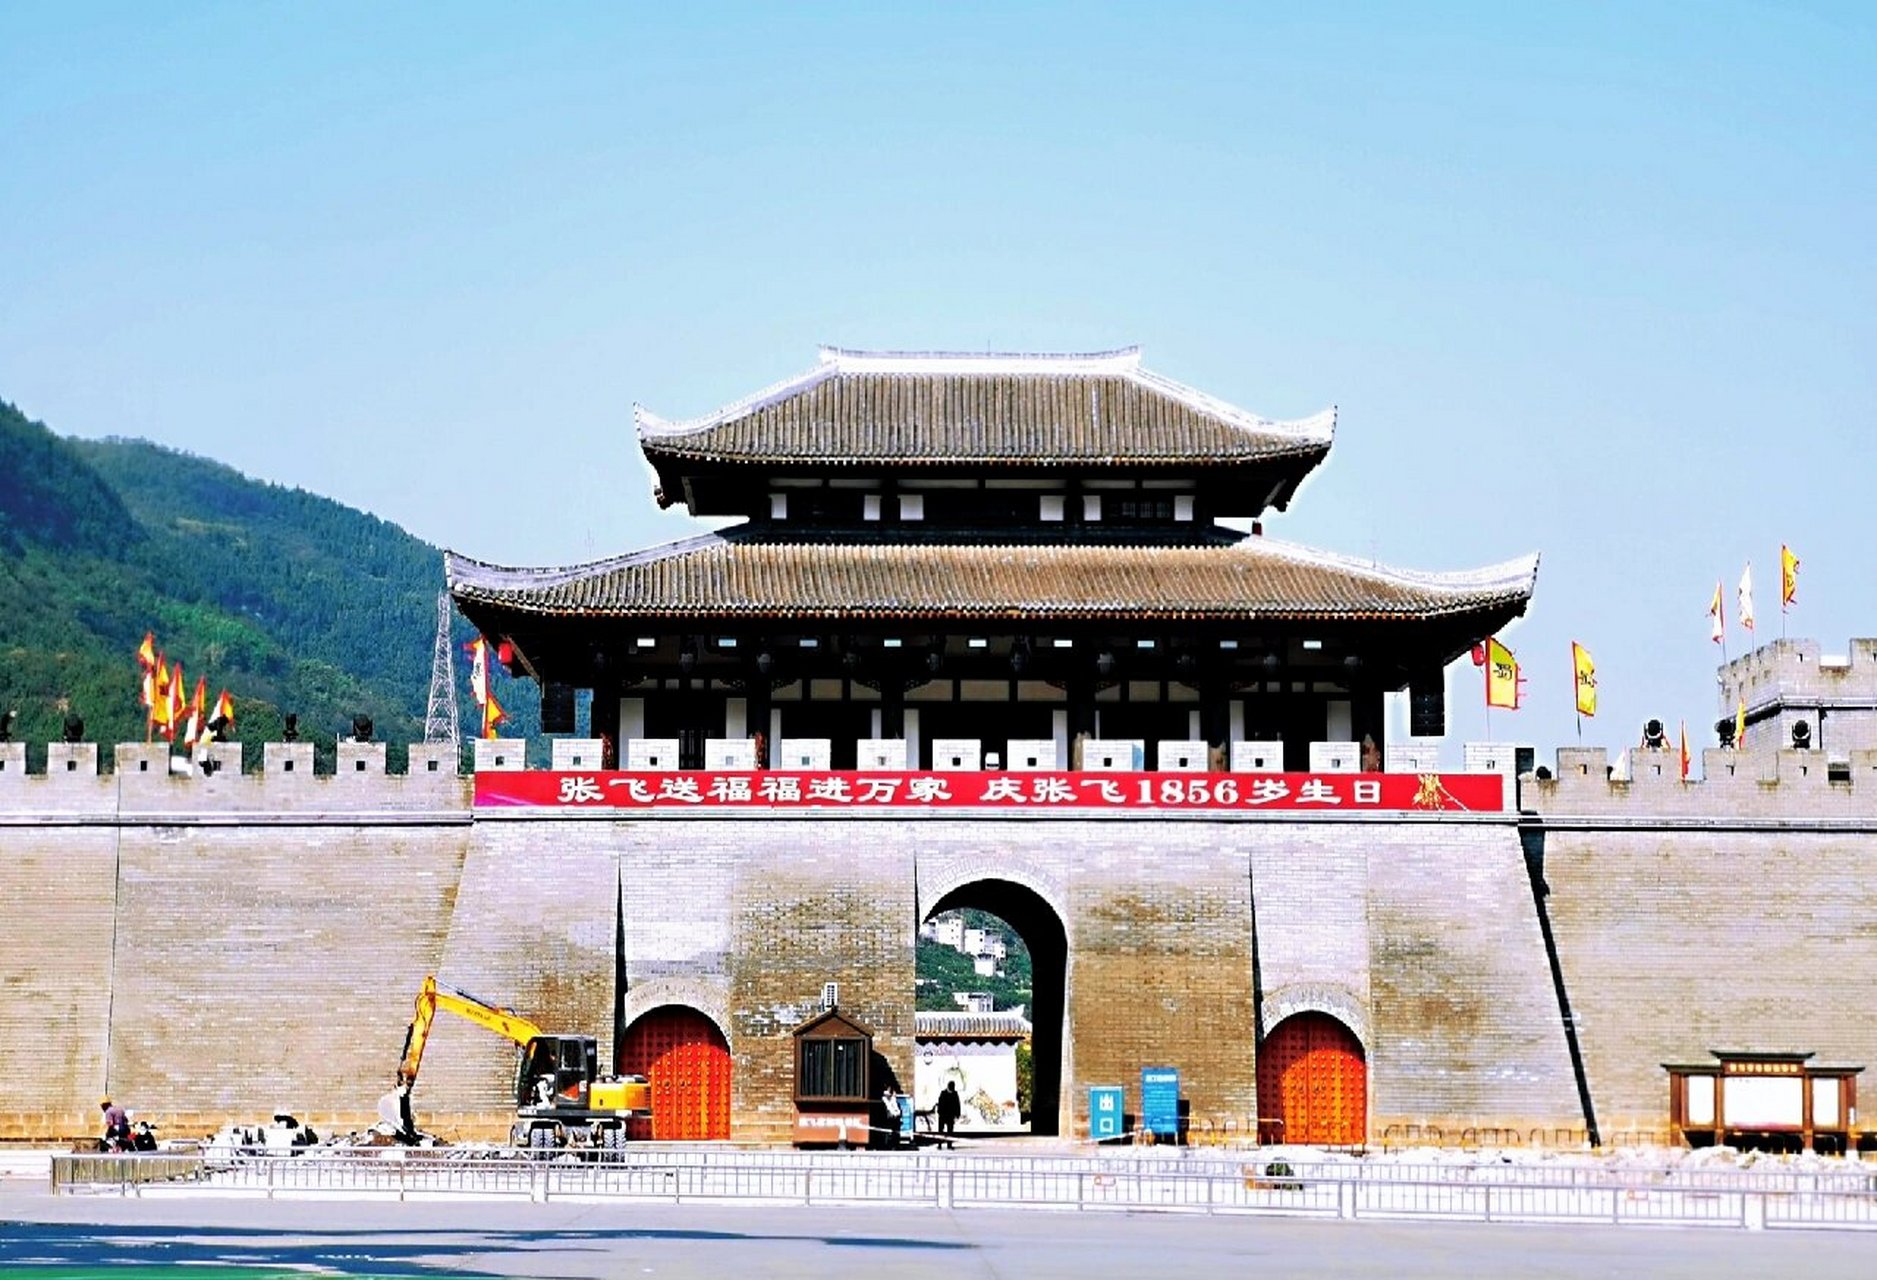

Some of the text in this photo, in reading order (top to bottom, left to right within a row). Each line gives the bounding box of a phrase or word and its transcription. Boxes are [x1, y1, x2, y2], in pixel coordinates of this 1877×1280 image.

[558, 777, 1381, 805] 张飞送福福进万家 庆张飞1856岁生日
